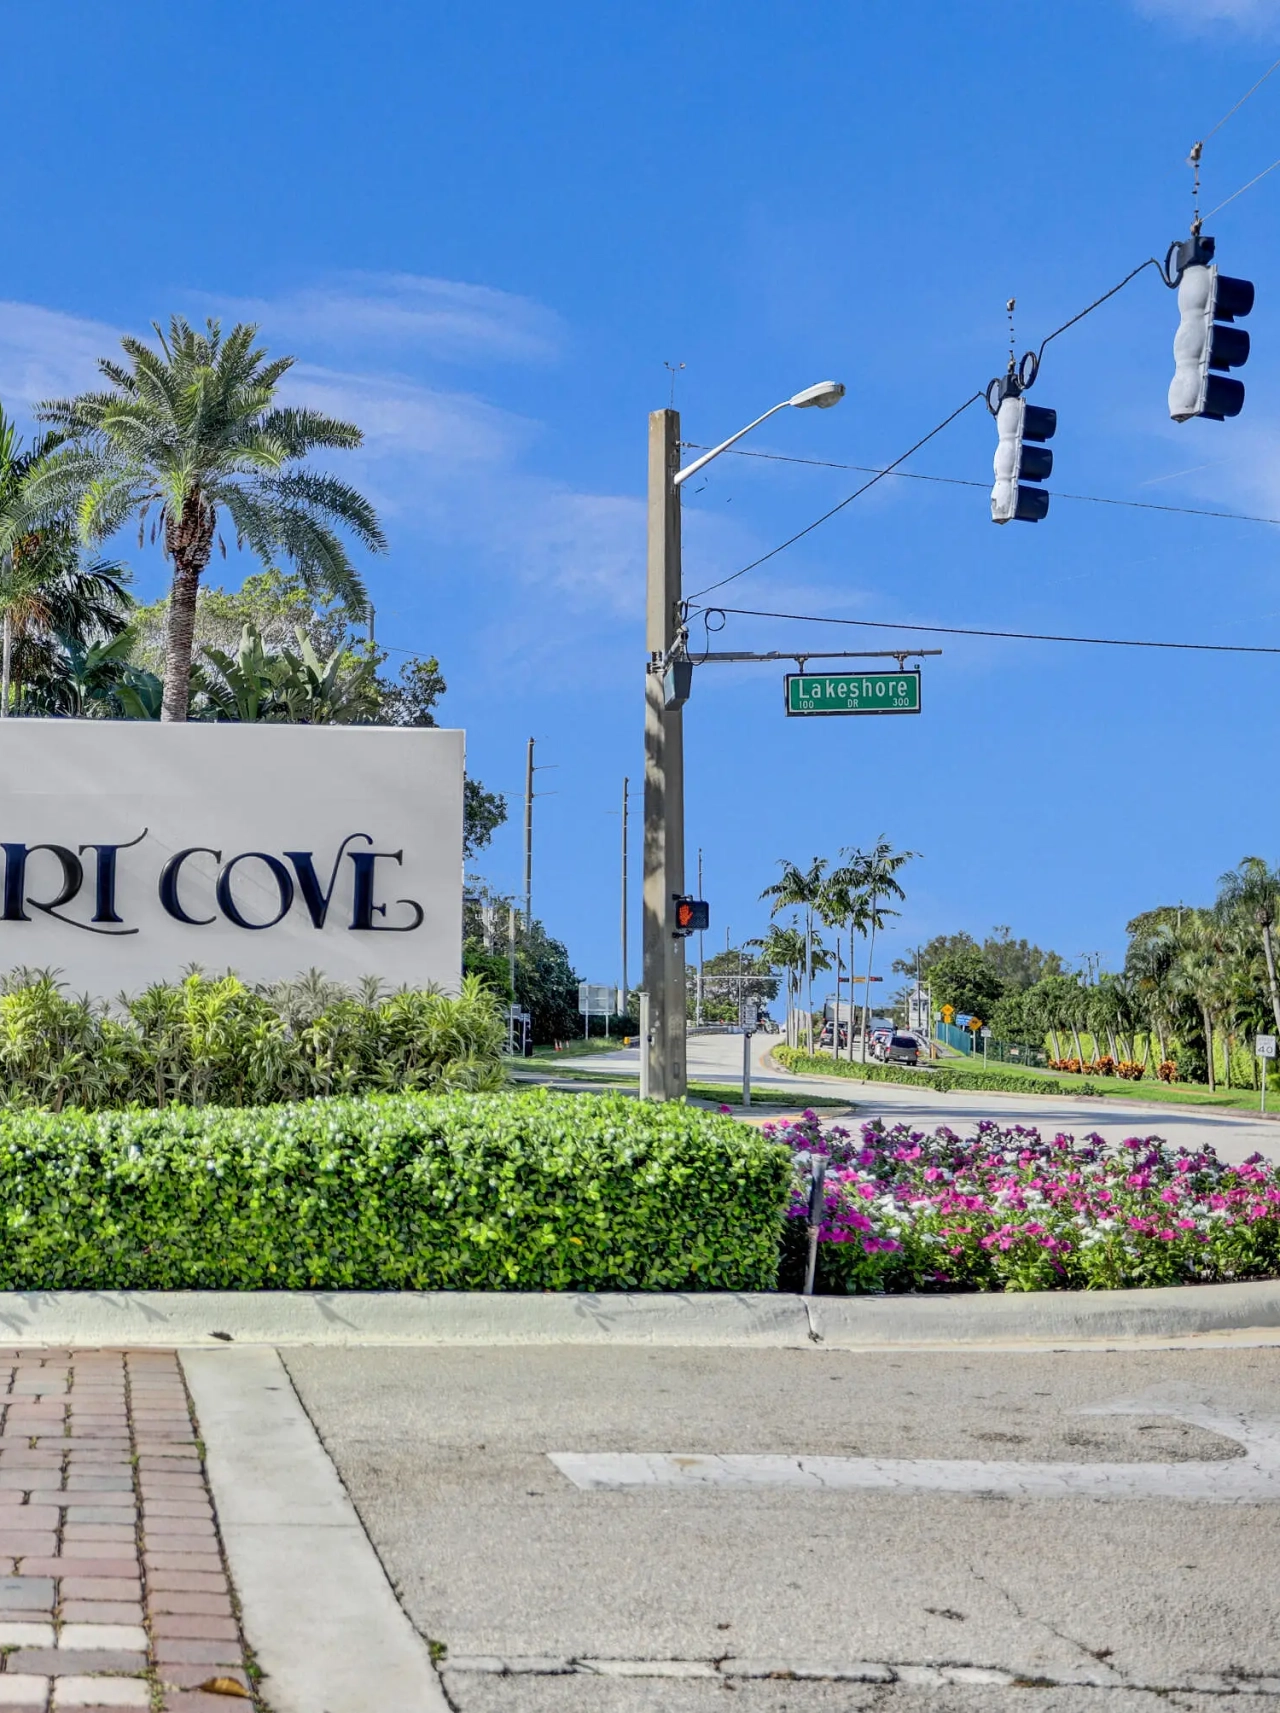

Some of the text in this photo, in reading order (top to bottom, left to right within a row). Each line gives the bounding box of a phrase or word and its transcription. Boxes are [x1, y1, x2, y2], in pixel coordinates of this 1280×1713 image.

[799, 678, 908, 698] Lakeshore
[799, 697, 910, 709] 100 DR 300
[158, 831, 425, 932] COVE
[1258, 1046, 1273, 1054] 40
